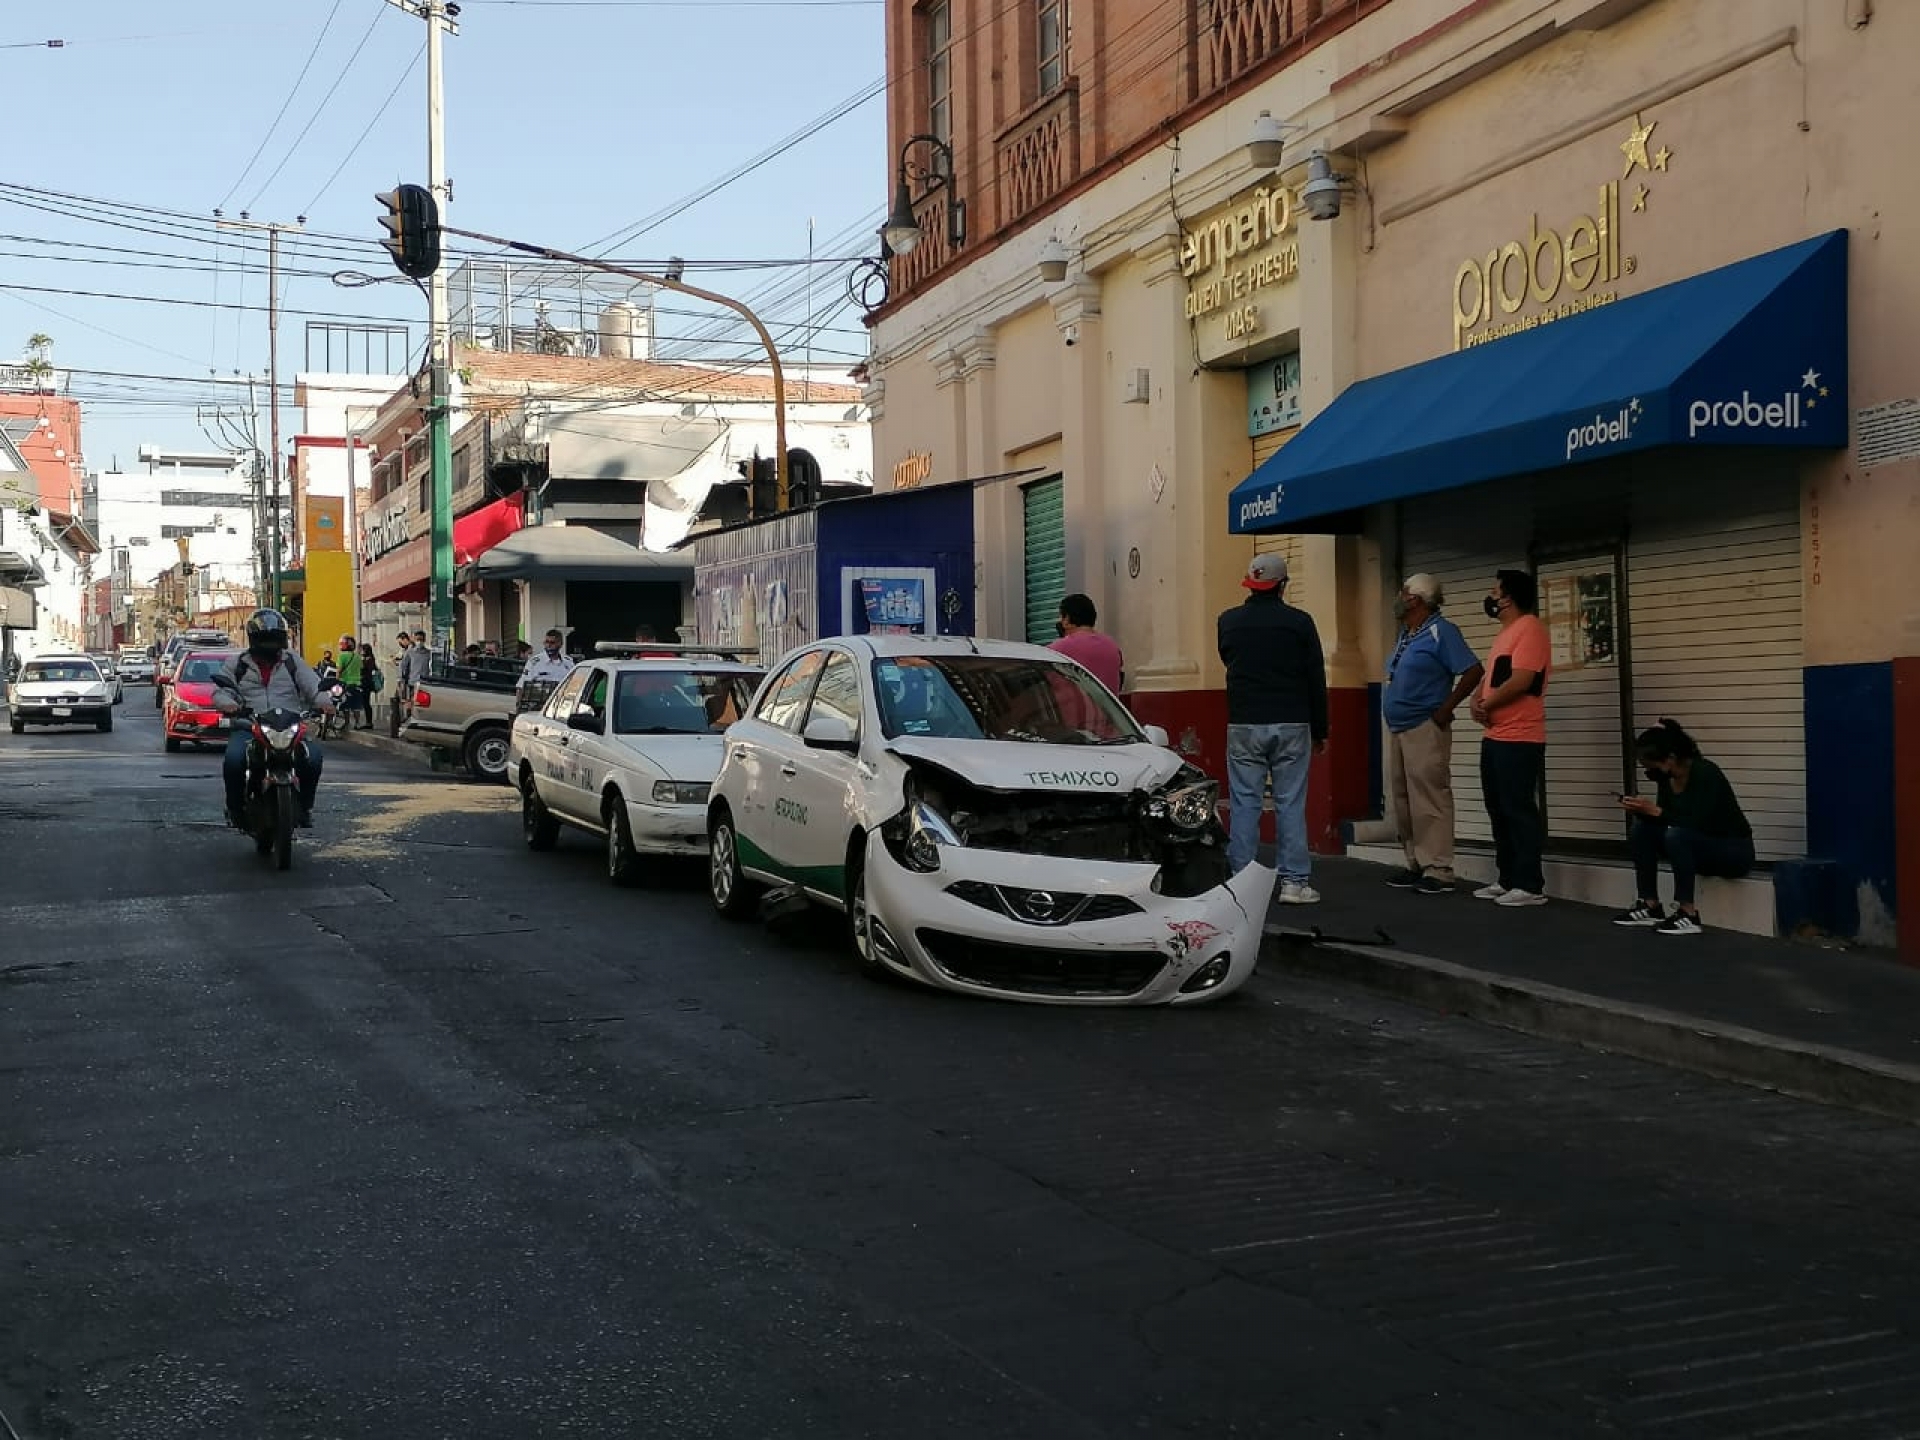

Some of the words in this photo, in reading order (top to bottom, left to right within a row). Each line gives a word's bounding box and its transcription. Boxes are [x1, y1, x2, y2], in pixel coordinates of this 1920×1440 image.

[1181, 187, 1289, 277] empeño
[1220, 270, 1244, 301] TE
[1249, 243, 1299, 291] PRESTA
[1453, 180, 1620, 352] probell
[1566, 408, 1629, 460] probell
[1689, 391, 1800, 438] probell
[1241, 491, 1278, 528] probell
[1024, 771, 1120, 788] TEMIXCO
